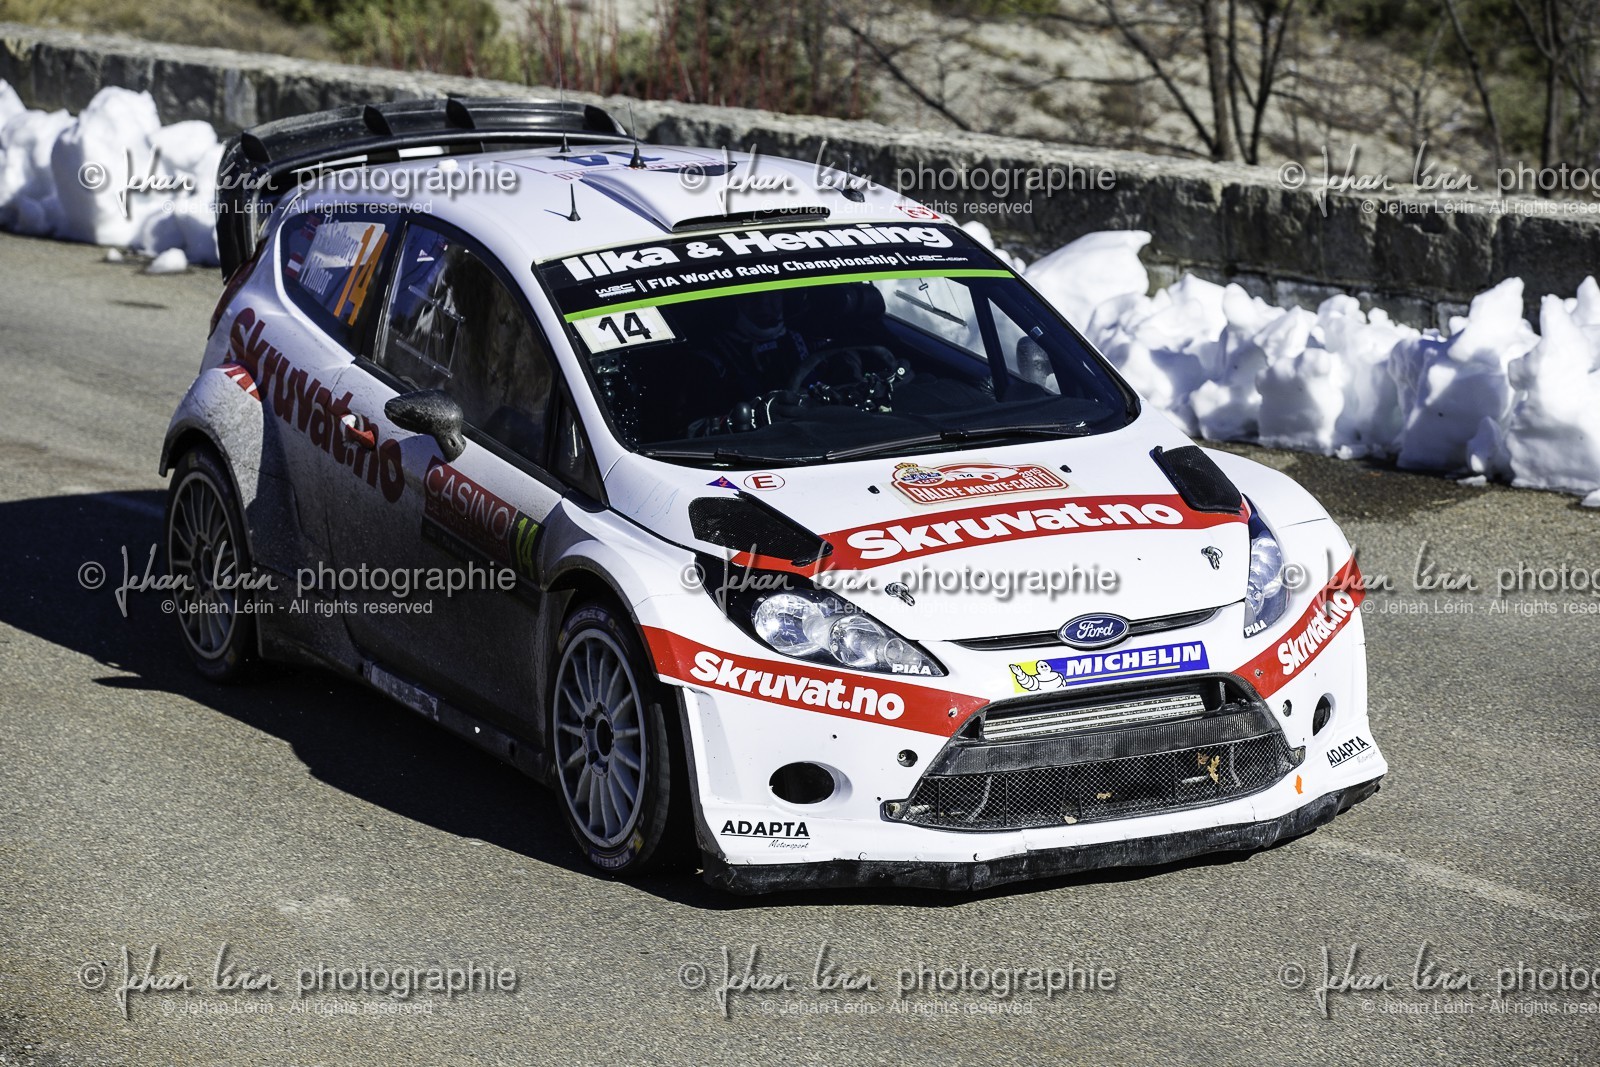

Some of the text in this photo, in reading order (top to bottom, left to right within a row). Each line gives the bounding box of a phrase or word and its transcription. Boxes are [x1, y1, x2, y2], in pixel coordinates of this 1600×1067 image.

[561, 223, 953, 280] Ilka & Henning
[333, 225, 389, 327] 14
[647, 274, 680, 290] FIA
[680, 268, 732, 285] World
[736, 261, 779, 280] Rally
[783, 253, 899, 272] Championship
[598, 311, 652, 344] 14
[228, 307, 405, 503] Skruvat.no
[752, 475, 777, 489] E
[908, 484, 964, 502] RALLYE
[967, 472, 1060, 495] MONTE-CARLO
[1018, 467, 1041, 479] 2015
[426, 464, 510, 541] CASINO
[847, 502, 1184, 560] Skruvat.no
[1076, 619, 1114, 640] Ford
[1244, 619, 1267, 638] PIAA
[1277, 590, 1355, 676] Skruvat.no
[892, 664, 932, 676] PIAA
[1066, 644, 1202, 677] MICHELIN
[690, 651, 905, 720] Skruvat.no
[1326, 736, 1369, 766] ADAPTA
[721, 820, 810, 837] ADAPTA
